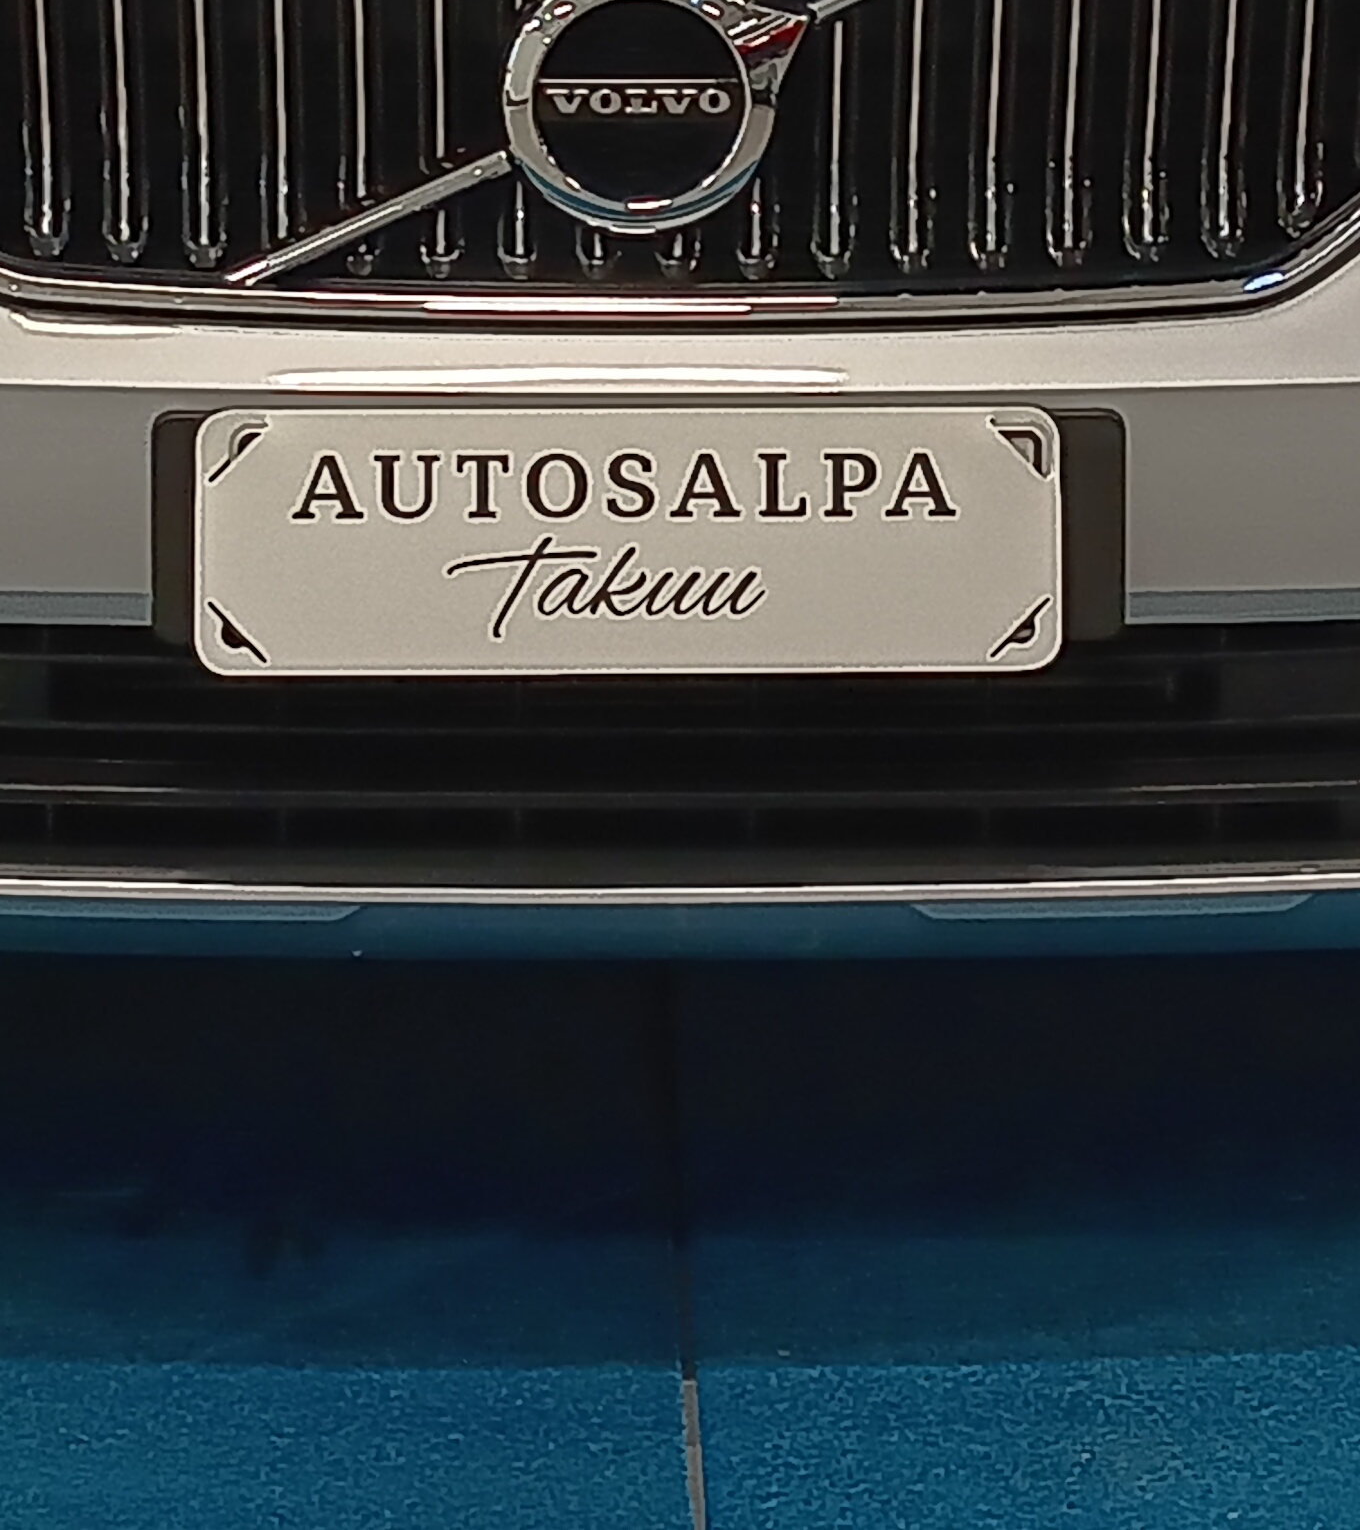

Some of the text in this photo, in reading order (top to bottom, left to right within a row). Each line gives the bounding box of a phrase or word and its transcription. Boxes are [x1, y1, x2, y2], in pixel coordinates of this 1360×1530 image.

[545, 88, 731, 114] VOLVO
[291, 450, 958, 520] AUTOSALPA
[444, 536, 766, 640] Takuu
